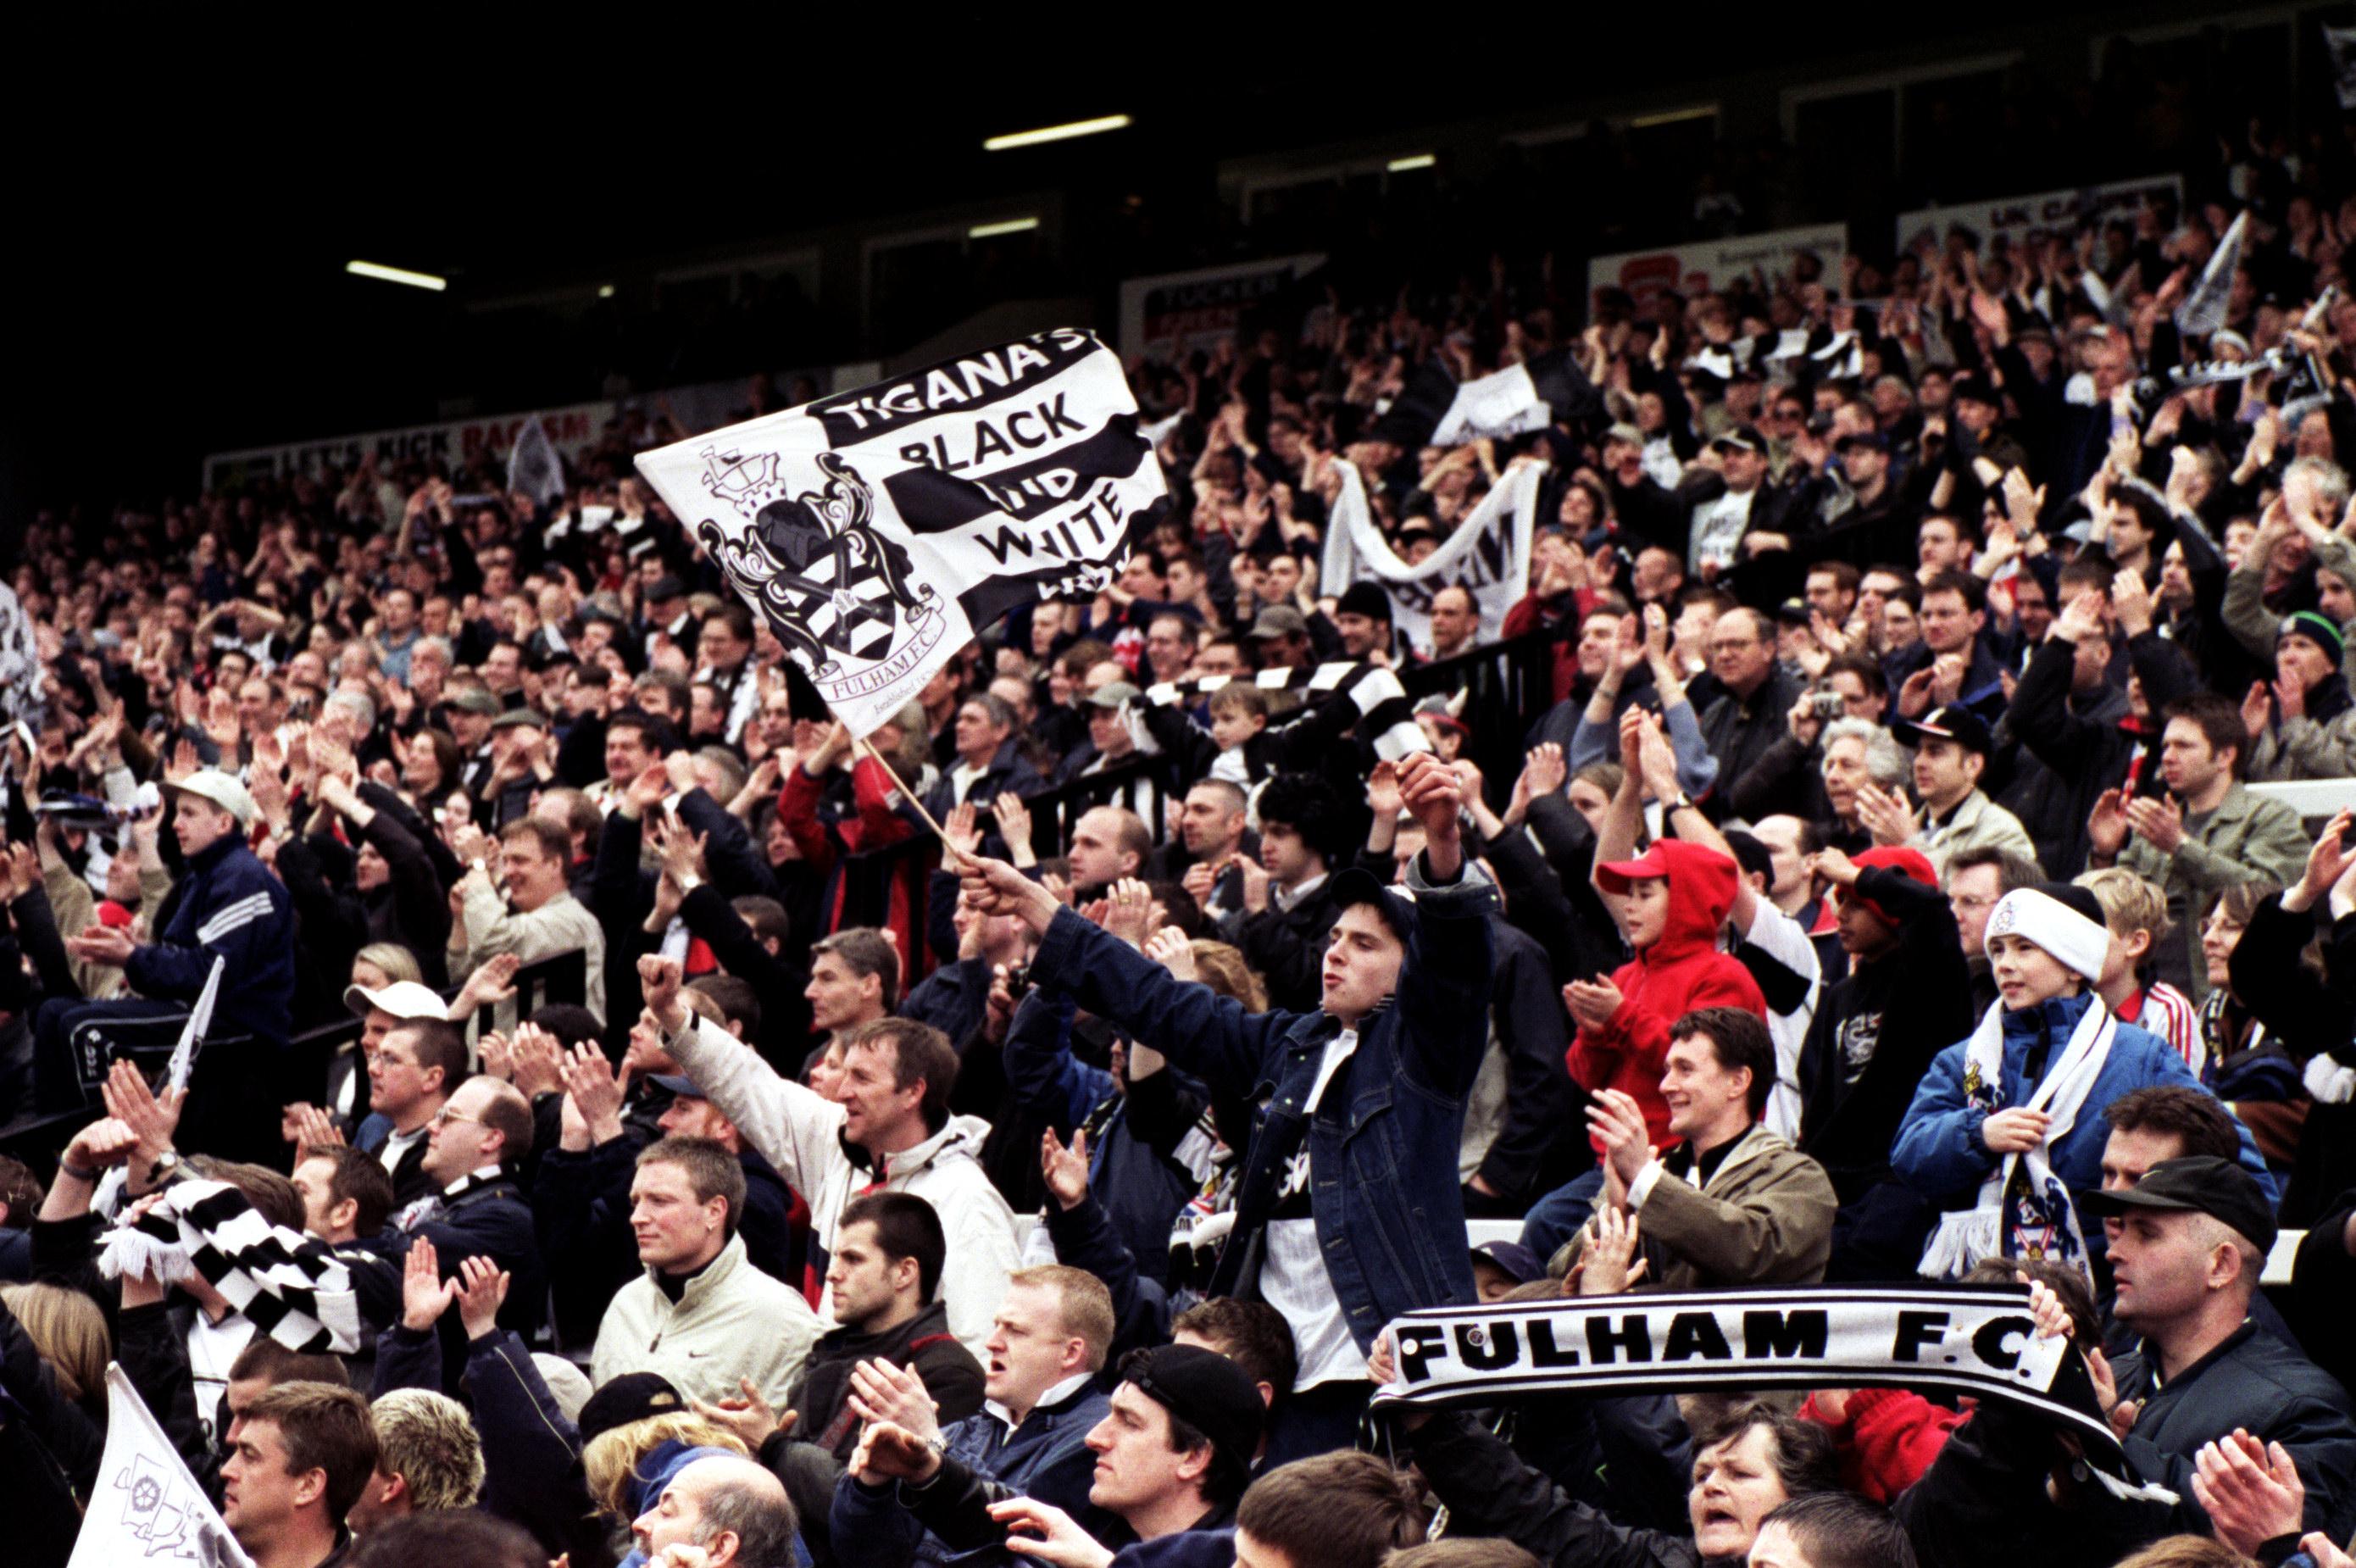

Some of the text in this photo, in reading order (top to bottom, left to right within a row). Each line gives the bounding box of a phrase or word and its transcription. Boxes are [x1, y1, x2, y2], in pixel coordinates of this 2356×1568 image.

[824, 327, 1087, 430] TIGANA'S
[376, 428, 449, 457] KICK
[462, 413, 589, 453] RACSM
[899, 391, 1088, 472] BLACK
[832, 654, 911, 699] FULHAM
[1396, 1310, 2037, 1384] FULHAM F.C.
